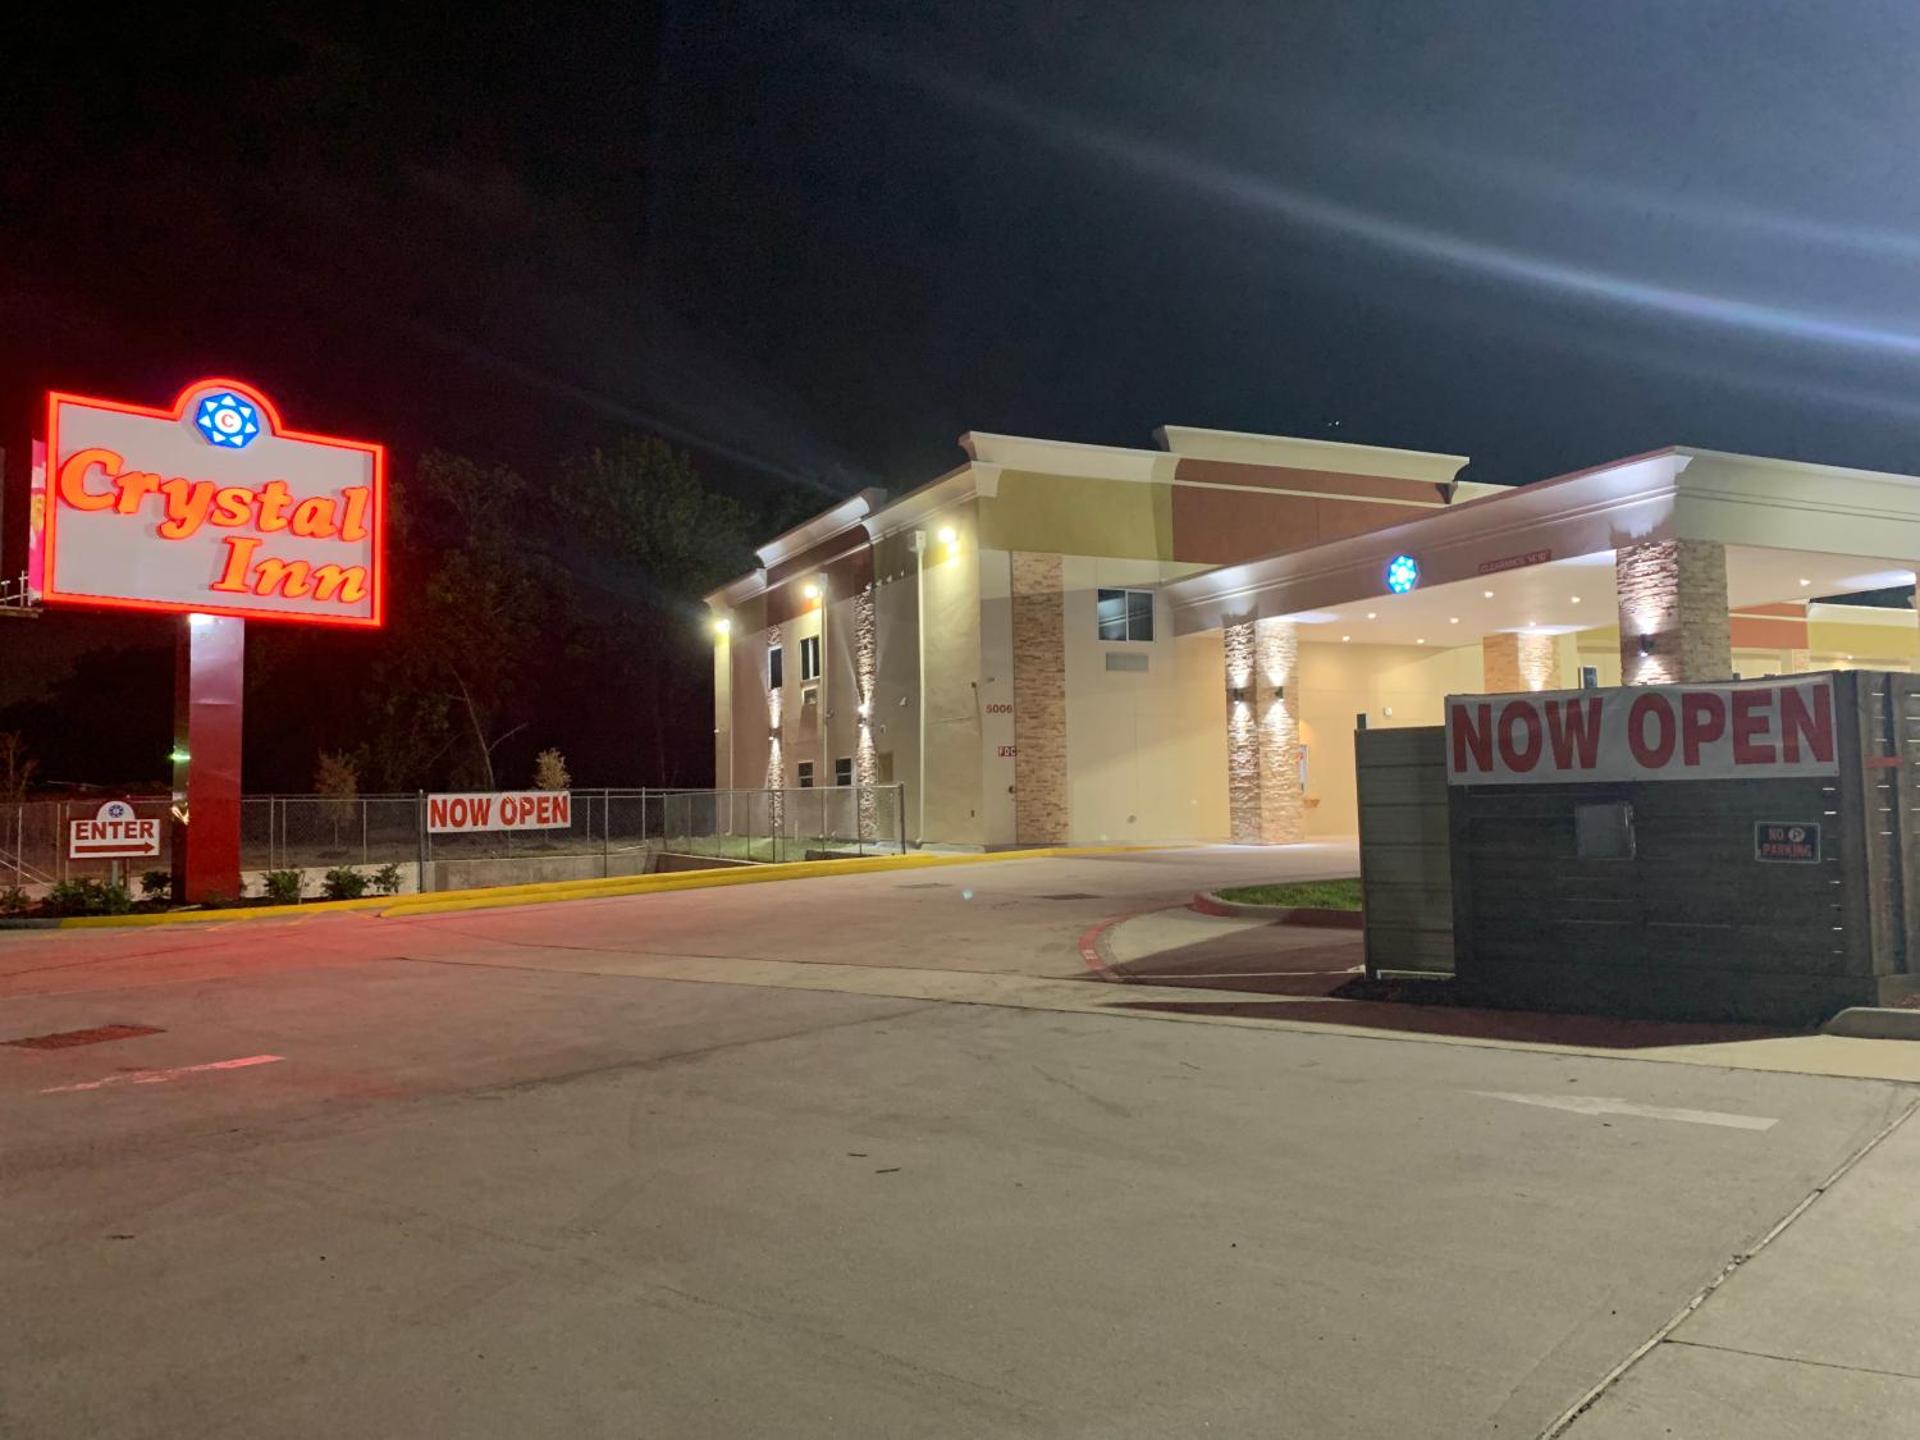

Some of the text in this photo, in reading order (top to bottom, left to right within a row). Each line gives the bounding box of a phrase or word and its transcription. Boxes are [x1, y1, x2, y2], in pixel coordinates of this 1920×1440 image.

[221, 413, 234, 429] C
[59, 448, 369, 542] Crystal
[210, 536, 367, 604] Inn
[1452, 684, 1834, 773] NOW OPEN
[430, 795, 568, 828] NOW OPEN
[75, 821, 154, 841] ENTER
[1768, 827, 1784, 841] NO
